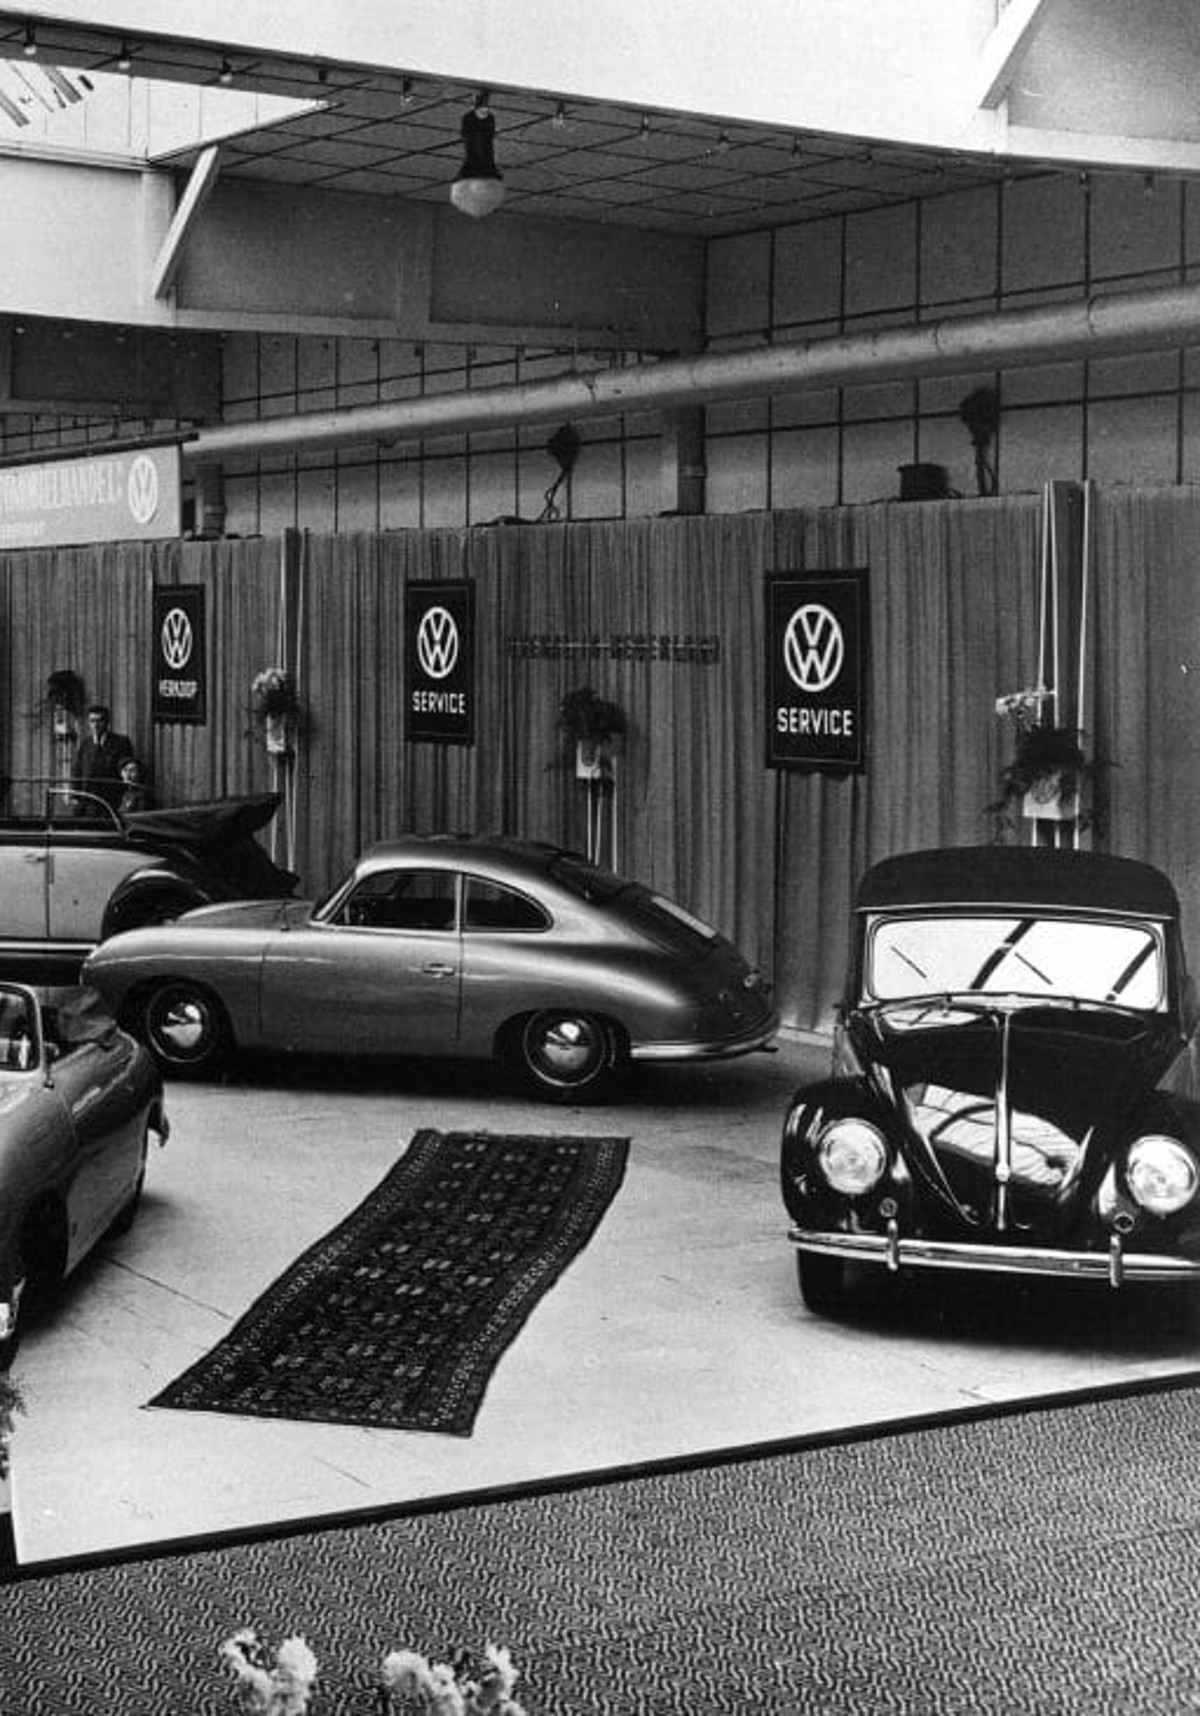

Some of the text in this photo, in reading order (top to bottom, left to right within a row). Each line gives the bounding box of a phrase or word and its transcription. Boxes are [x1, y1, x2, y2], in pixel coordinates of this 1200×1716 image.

[161, 606, 194, 670] VW
[417, 606, 458, 679] VW
[784, 603, 844, 693] VW
[412, 690, 467, 715] SERVICE
[776, 706, 853, 737] SERVICE
